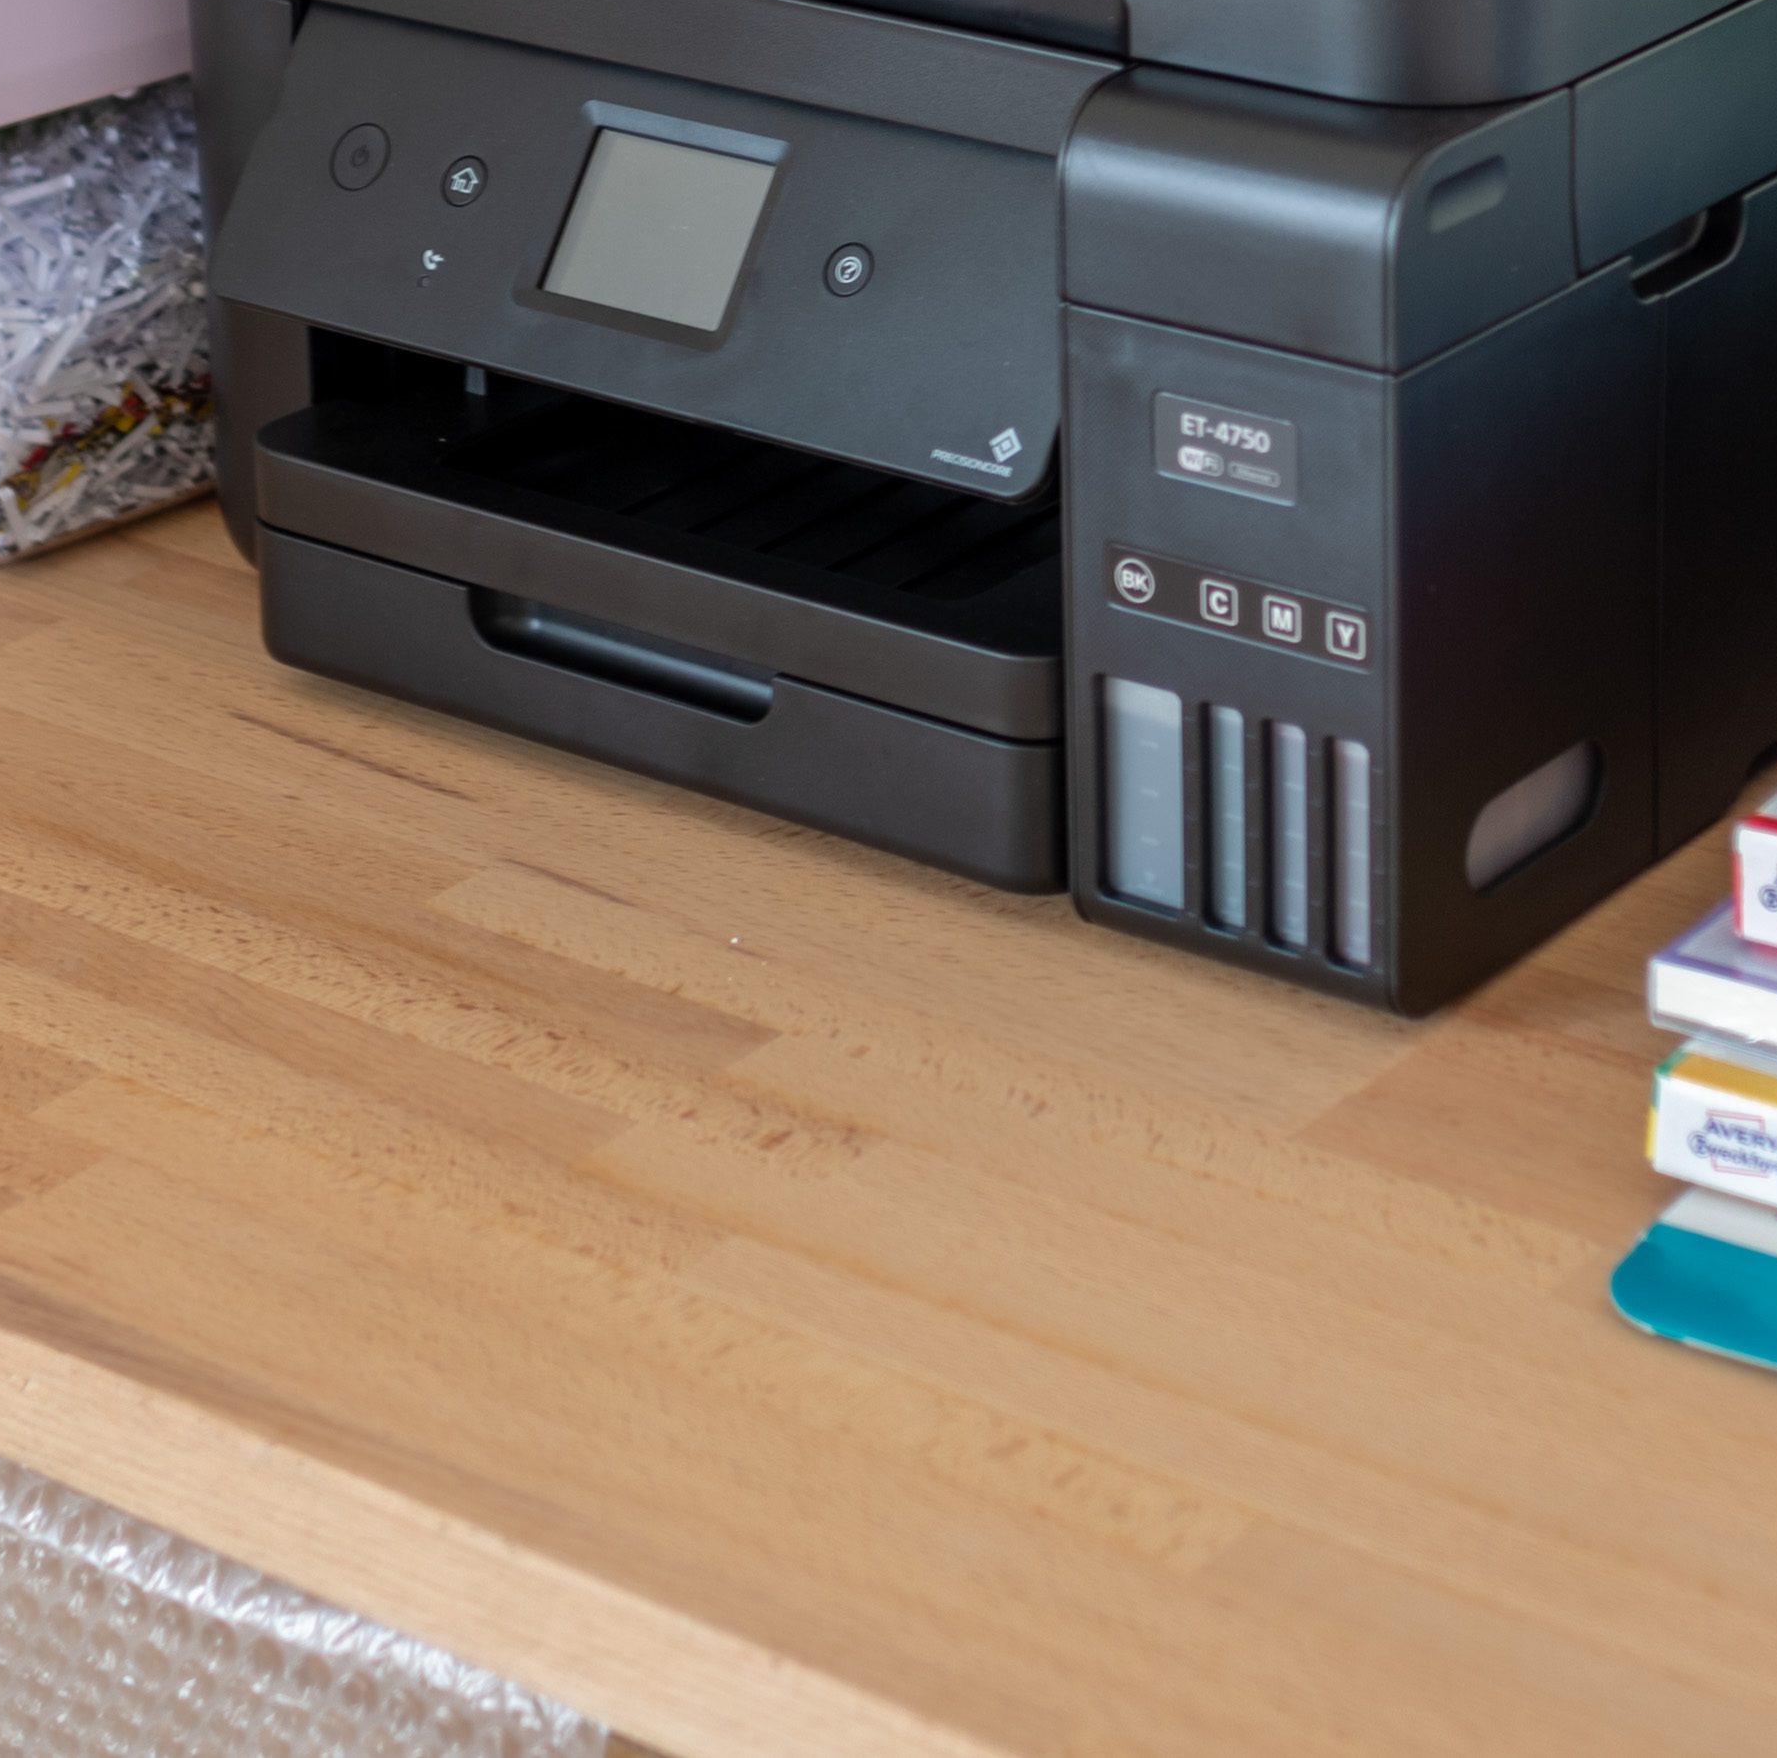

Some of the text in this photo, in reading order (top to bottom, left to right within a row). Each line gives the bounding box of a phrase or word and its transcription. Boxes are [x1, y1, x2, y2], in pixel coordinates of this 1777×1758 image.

[1179, 411, 1272, 455] ET-4750
[1120, 568, 1150, 593] BK
[1208, 590, 1229, 616] C
[1270, 606, 1295, 633] M
[1335, 623, 1356, 648] Y
